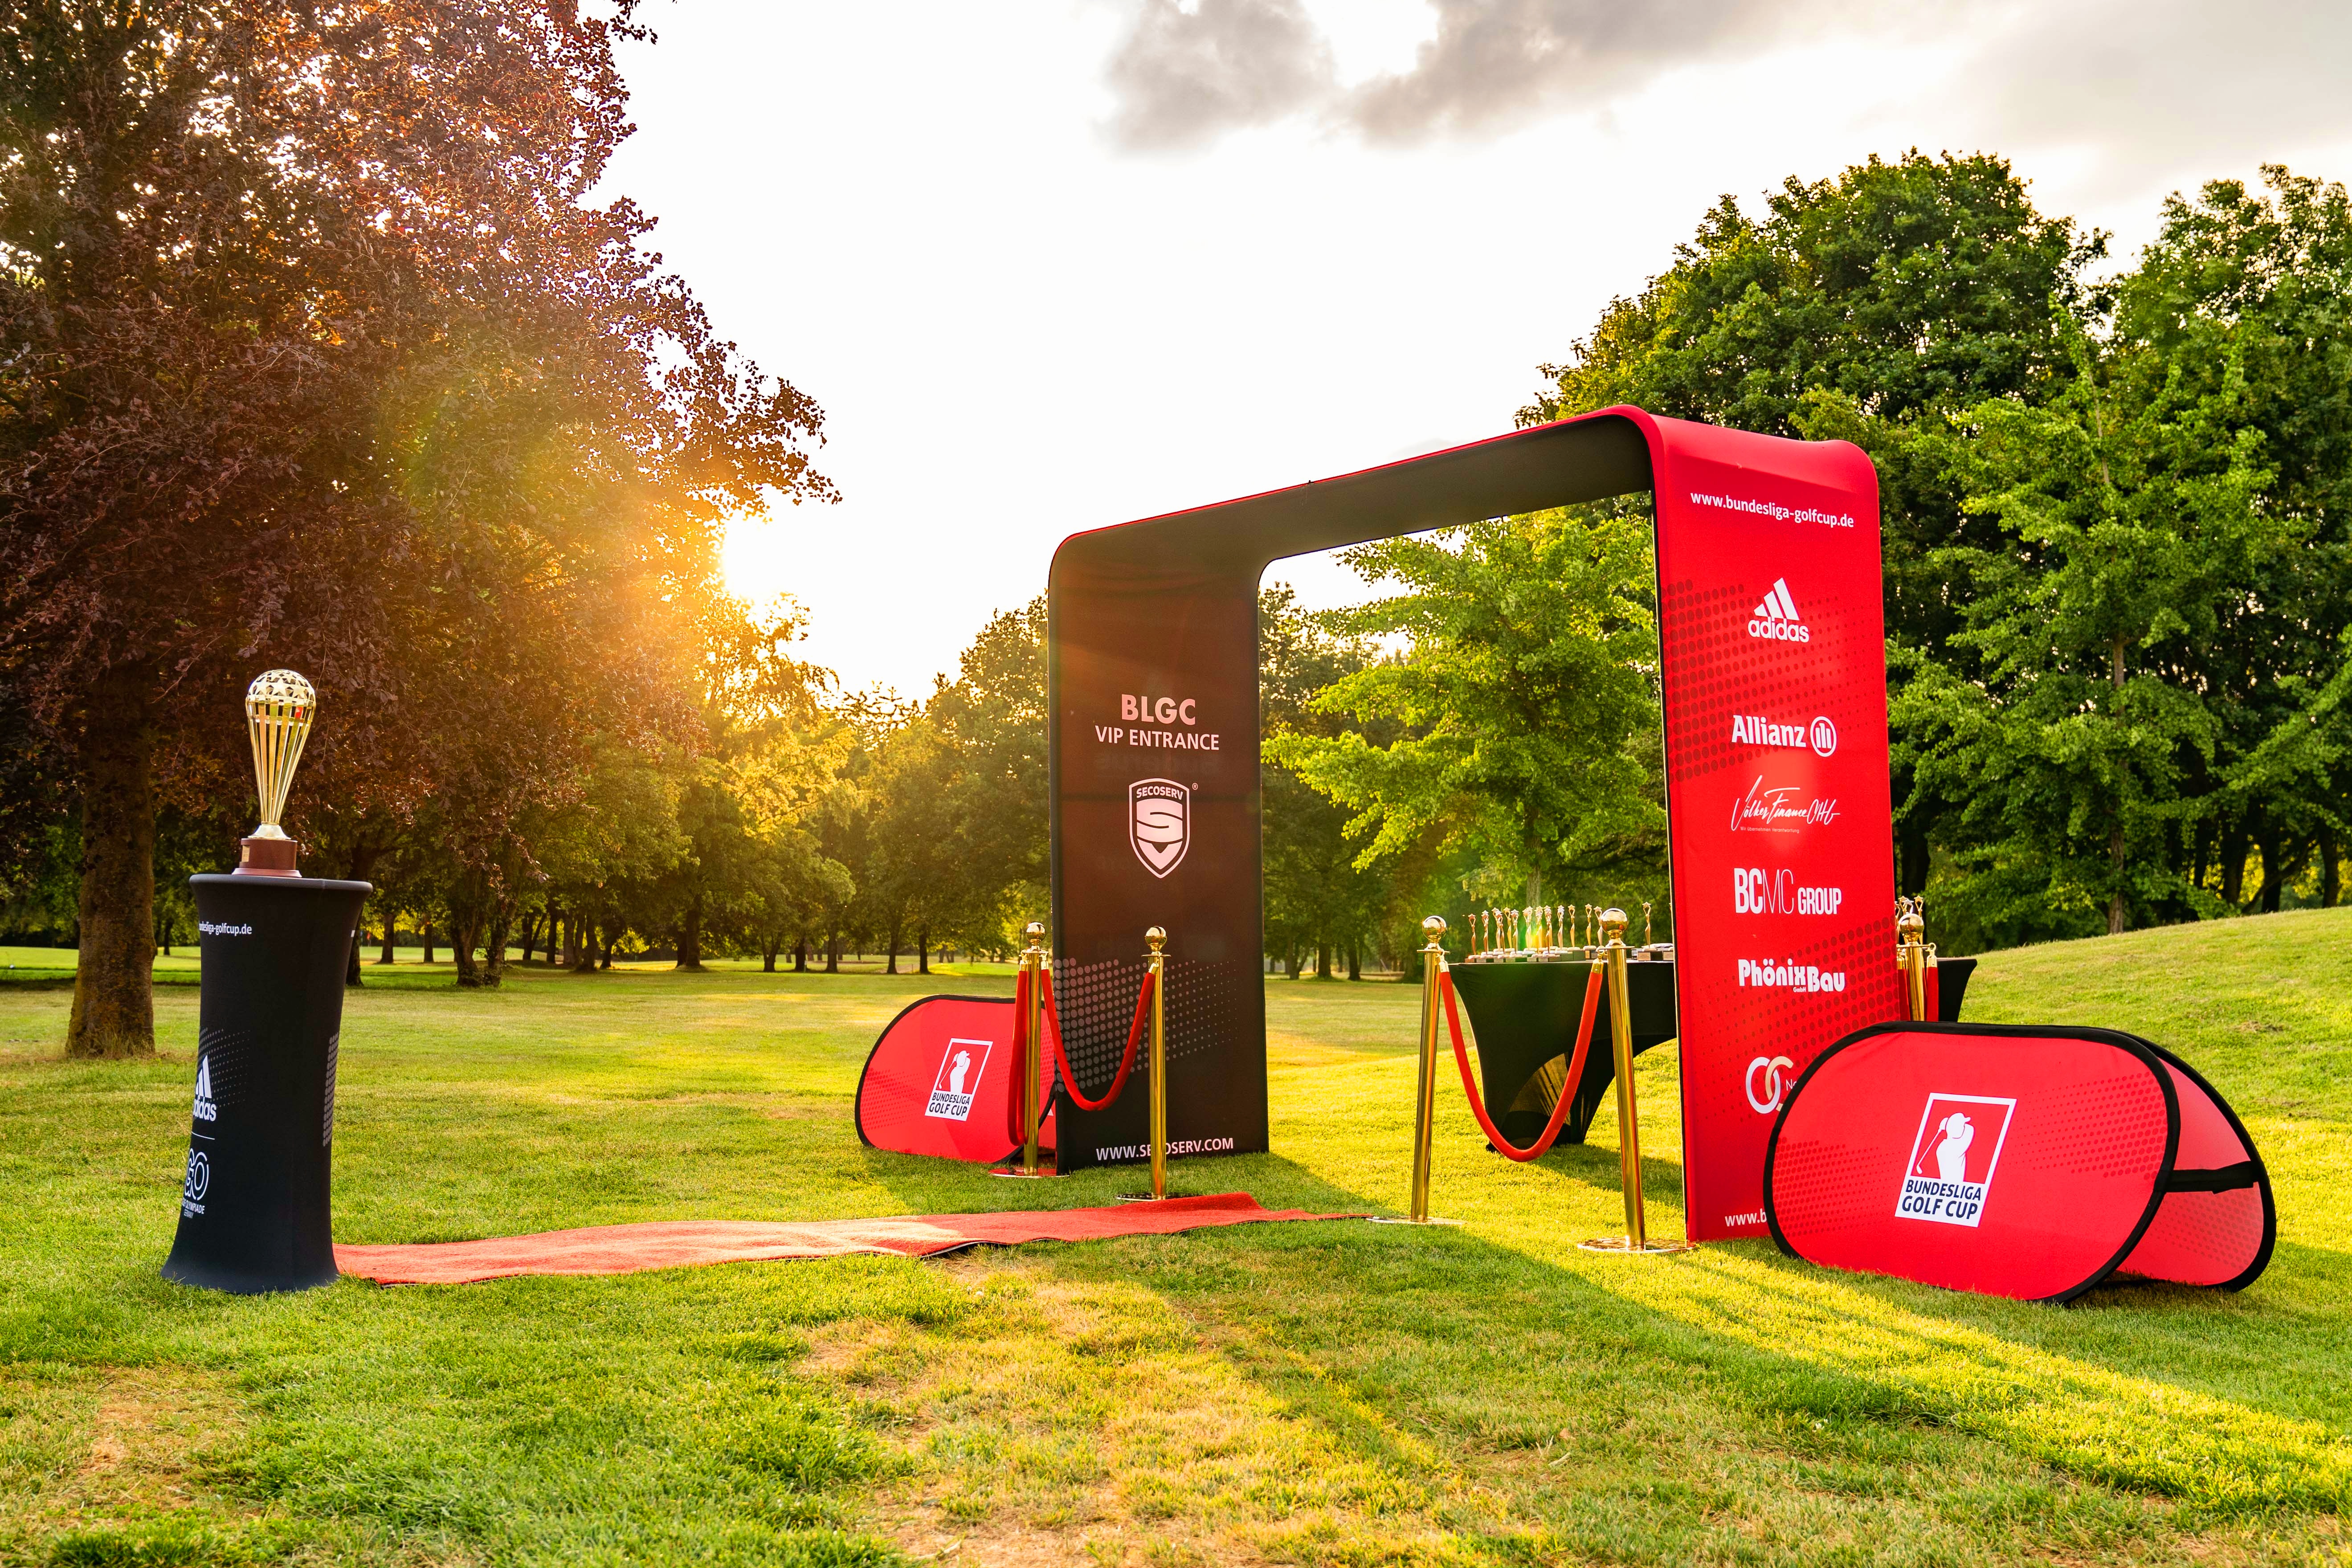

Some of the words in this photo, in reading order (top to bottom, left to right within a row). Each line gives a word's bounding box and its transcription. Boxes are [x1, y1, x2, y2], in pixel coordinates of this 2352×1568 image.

[1690, 492, 1854, 528] www.bundesliga-golfcup.de
[1748, 617, 1810, 643] adidas
[1121, 694, 1196, 725] BLGC
[1095, 725, 1123, 744] VIP
[1129, 729, 1219, 751] ENTRANCE
[1731, 715, 1806, 748] Allianz
[1136, 785, 1184, 800] SECOSERV
[1734, 868, 1794, 914] BCMC
[1797, 887, 1842, 915] GROUP
[929, 1102, 951, 1114] GOLF
[951, 1105, 968, 1117] CUP
[931, 1092, 971, 1105] BUNDESLIGA
[1096, 1138, 1234, 1161] WWW.SEOSERV.COM
[1905, 1179, 1981, 1201] BUNDESLIGA
[1902, 1195, 1943, 1215] GOLF
[1945, 1200, 1978, 1219] CUP
